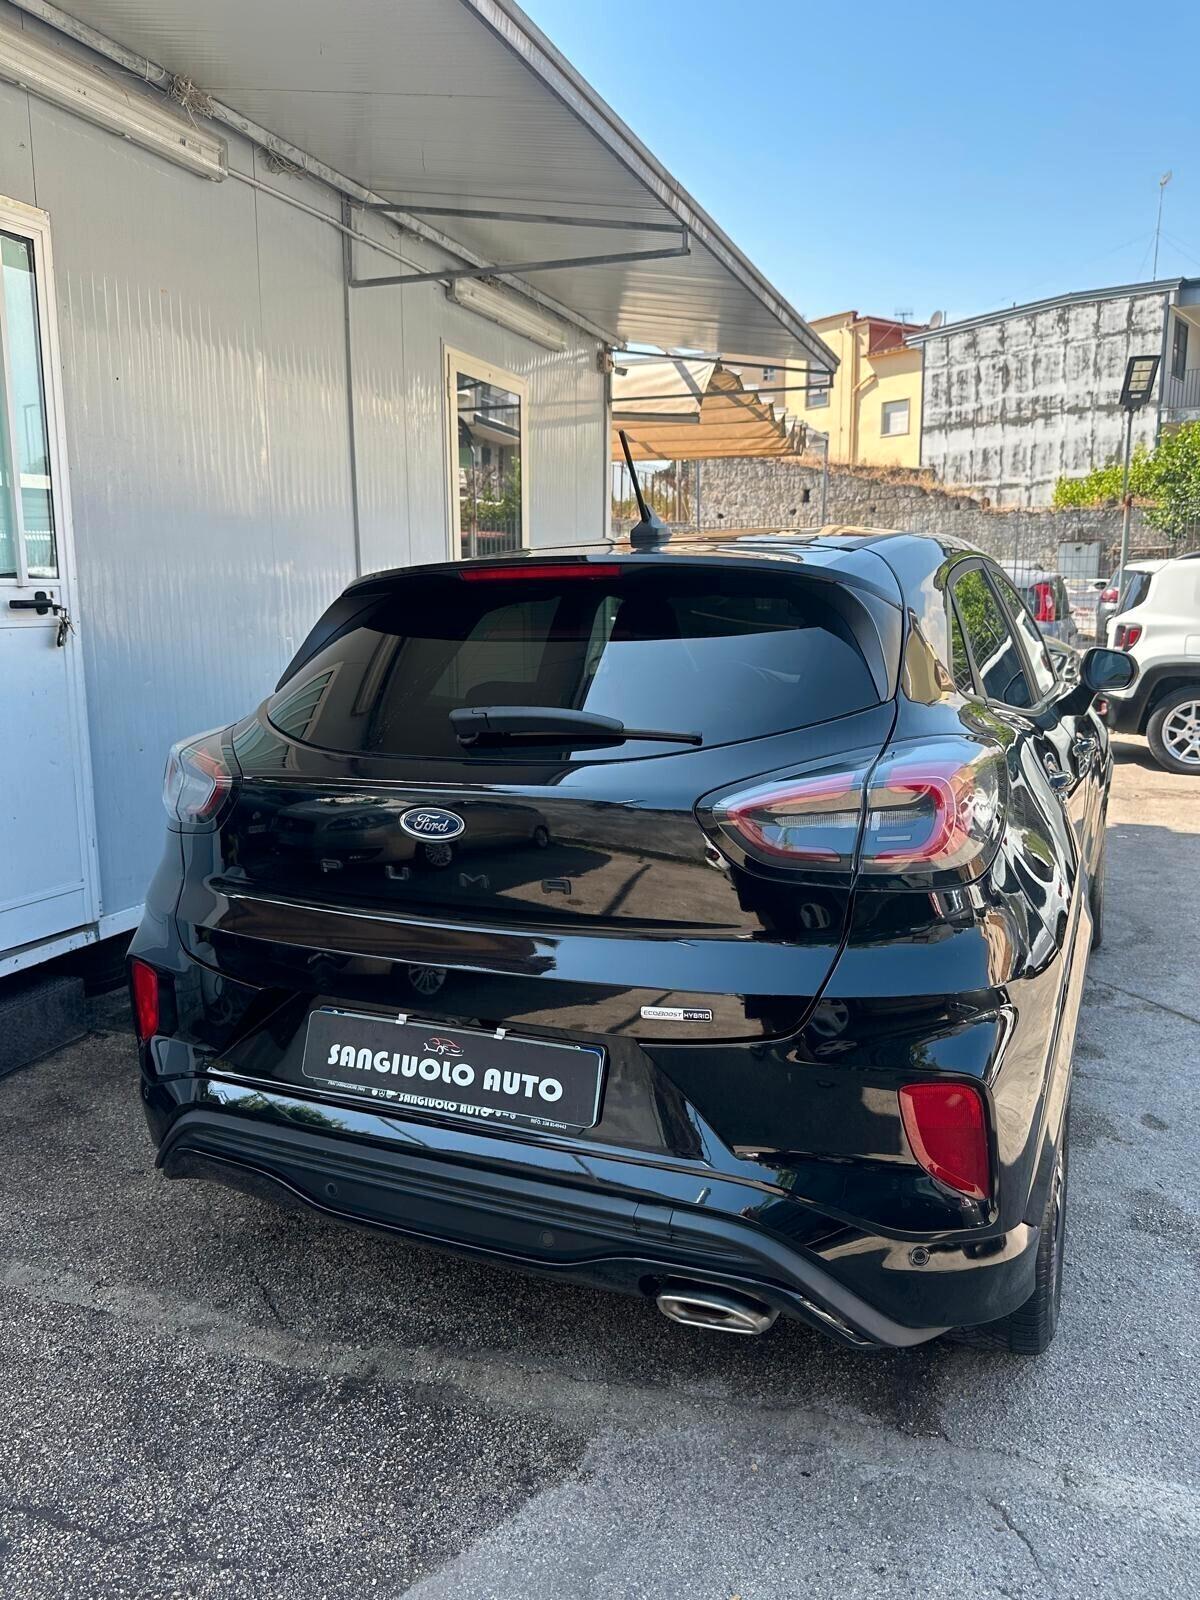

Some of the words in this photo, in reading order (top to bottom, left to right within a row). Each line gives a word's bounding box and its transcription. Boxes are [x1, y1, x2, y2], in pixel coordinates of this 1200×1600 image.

[415, 813, 449, 833] Ford
[320, 858, 572, 896] PUMA
[643, 1009, 682, 1018] ECOBOOST
[683, 1011, 710, 1020] HYBRID
[327, 1043, 475, 1087] SANGIUOLO
[483, 1067, 564, 1102] AUTO
[398, 1093, 457, 1112] SANGIUOLO
[459, 1103, 491, 1117] AUTO
